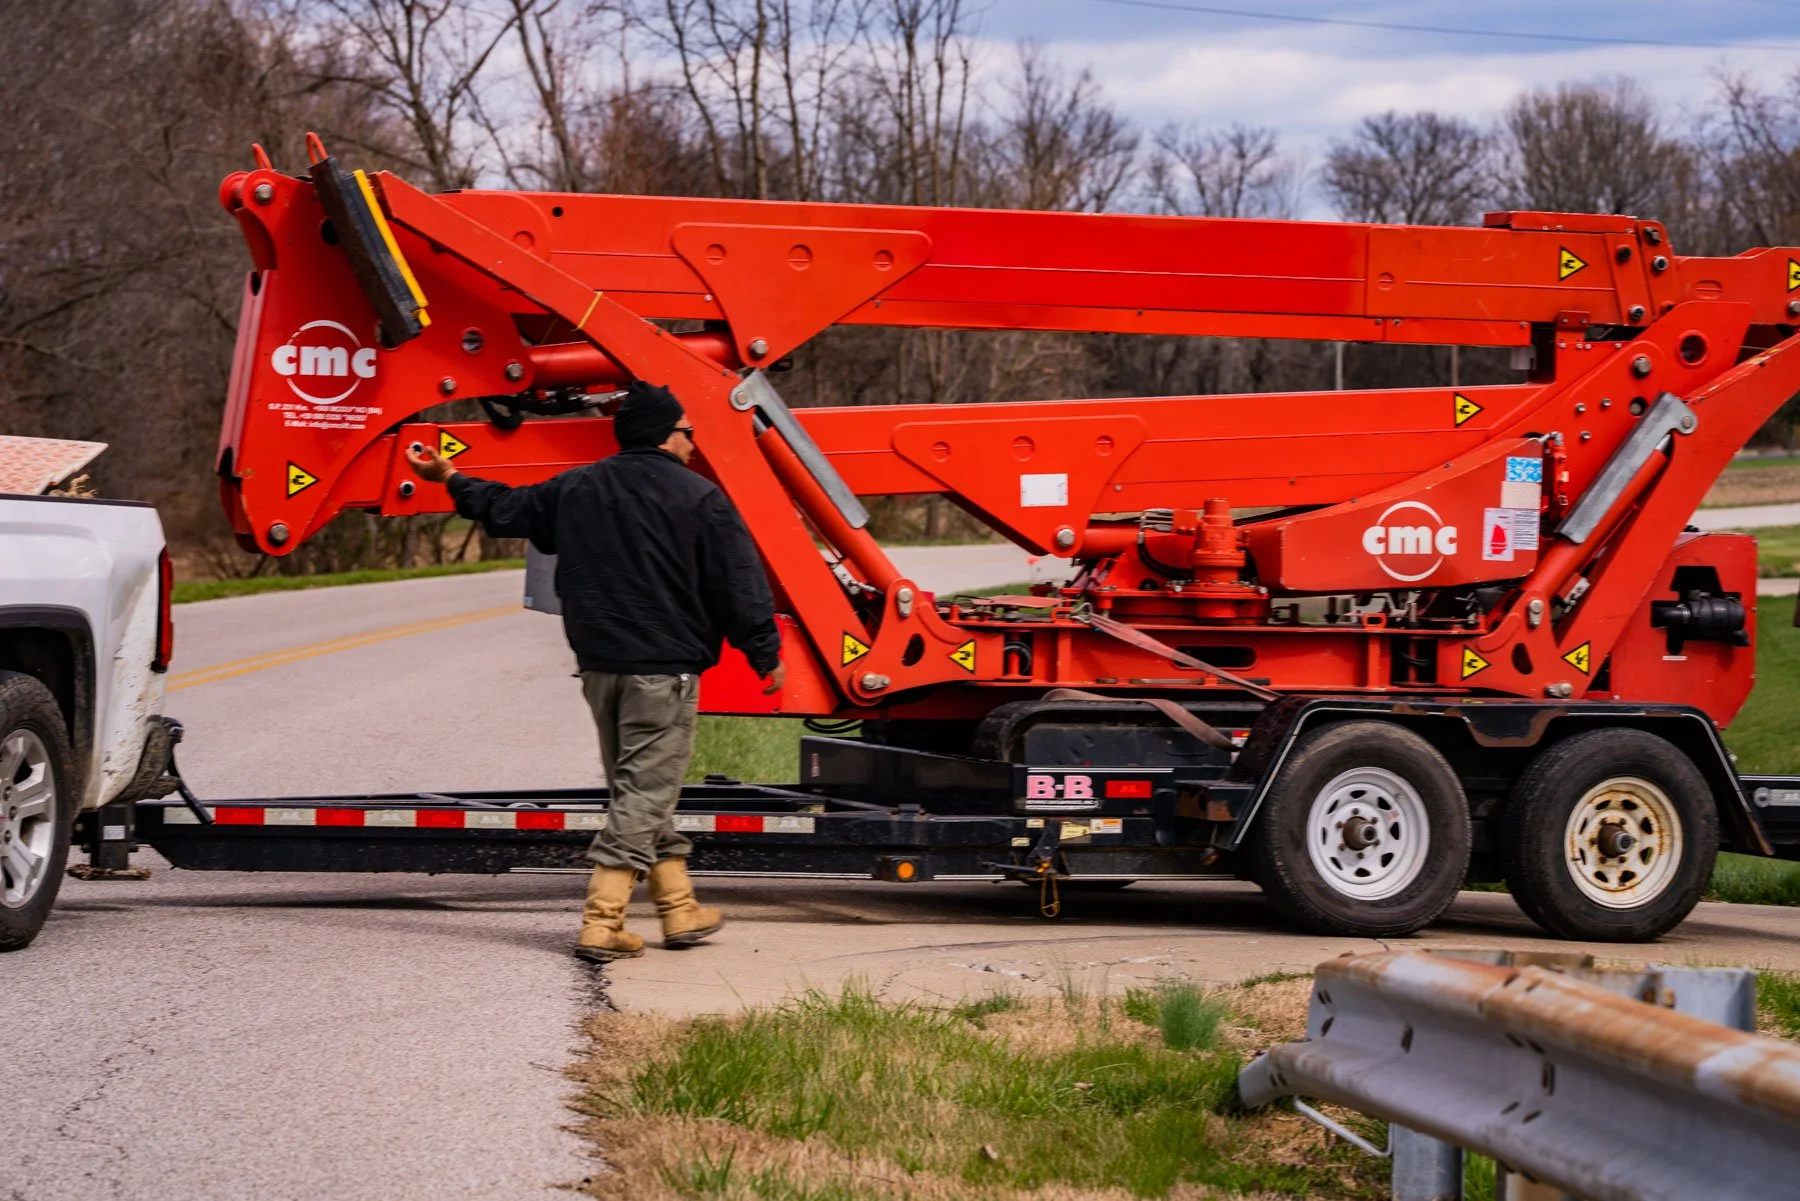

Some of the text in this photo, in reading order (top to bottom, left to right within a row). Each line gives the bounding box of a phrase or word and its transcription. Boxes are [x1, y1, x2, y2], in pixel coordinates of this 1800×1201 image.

[271, 344, 377, 378] cmc
[1362, 525, 1457, 556] cmc
[1026, 775, 1094, 799] B-B
